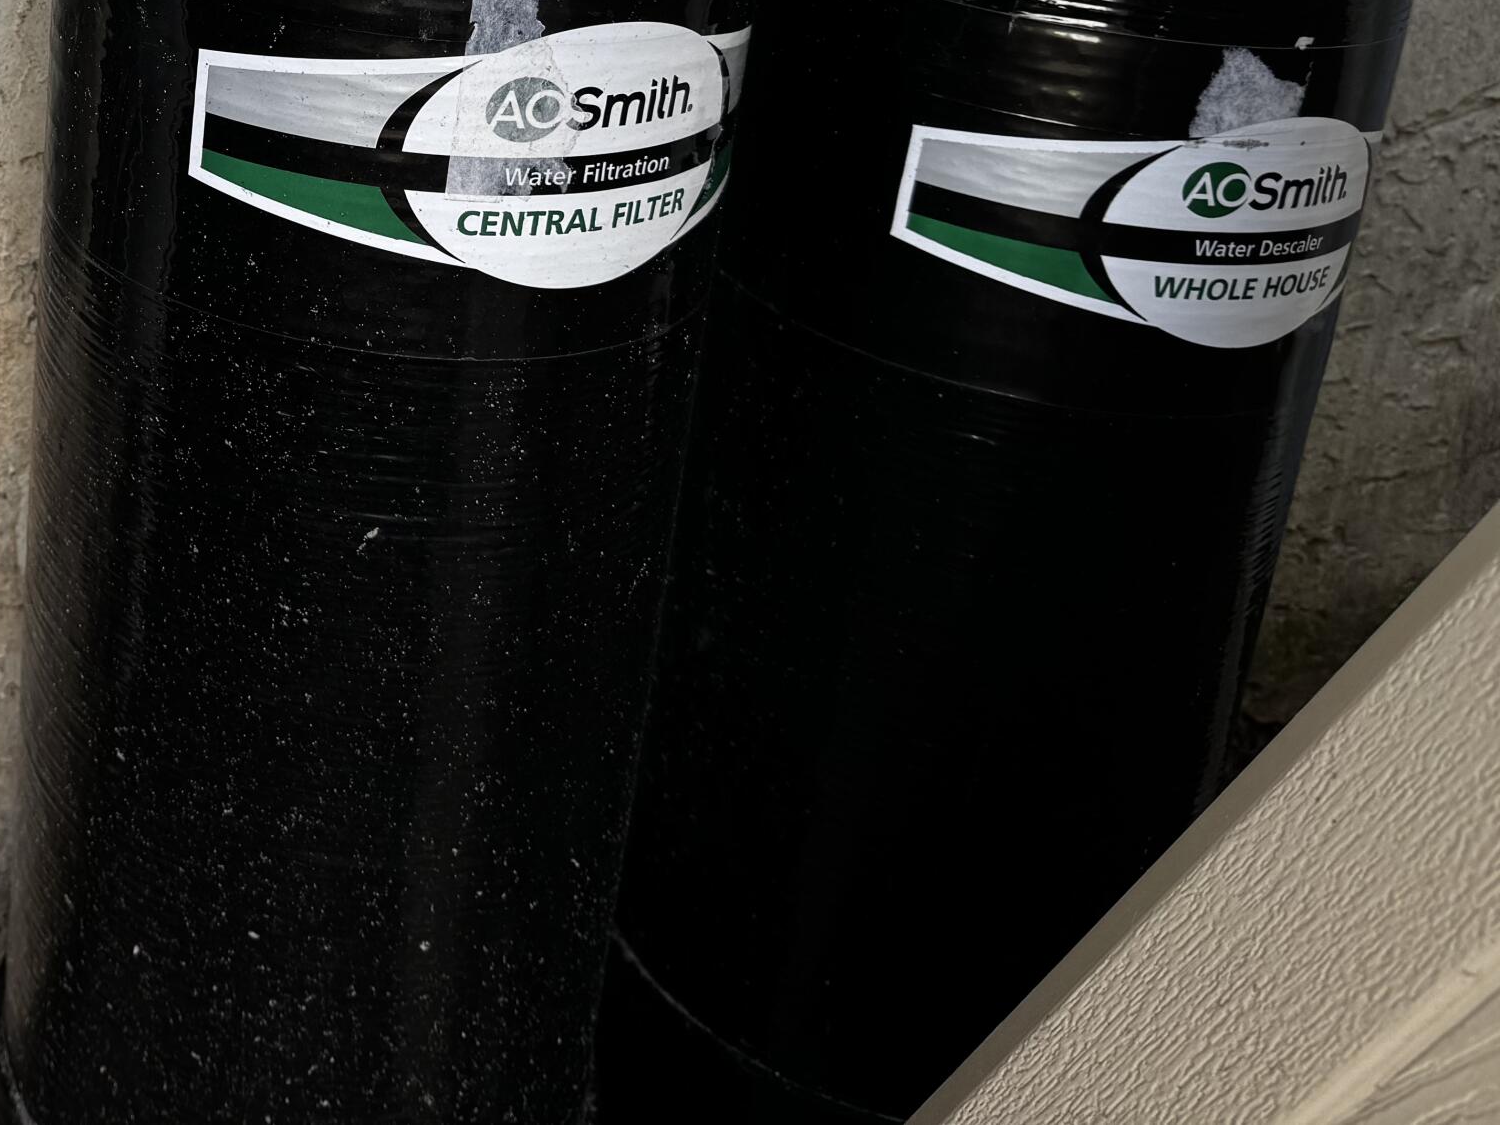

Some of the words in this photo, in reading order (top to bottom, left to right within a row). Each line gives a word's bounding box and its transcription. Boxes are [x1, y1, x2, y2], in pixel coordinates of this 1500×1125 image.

[505, 167, 576, 187] Water
[582, 156, 670, 184] Filtration
[457, 207, 602, 237] CENTRAL
[611, 187, 685, 229] FILTER
[1195, 239, 1256, 258] Water
[1259, 234, 1324, 257] Descaler
[1154, 275, 1258, 301] WHOLE
[1262, 265, 1332, 299] HOUSE
